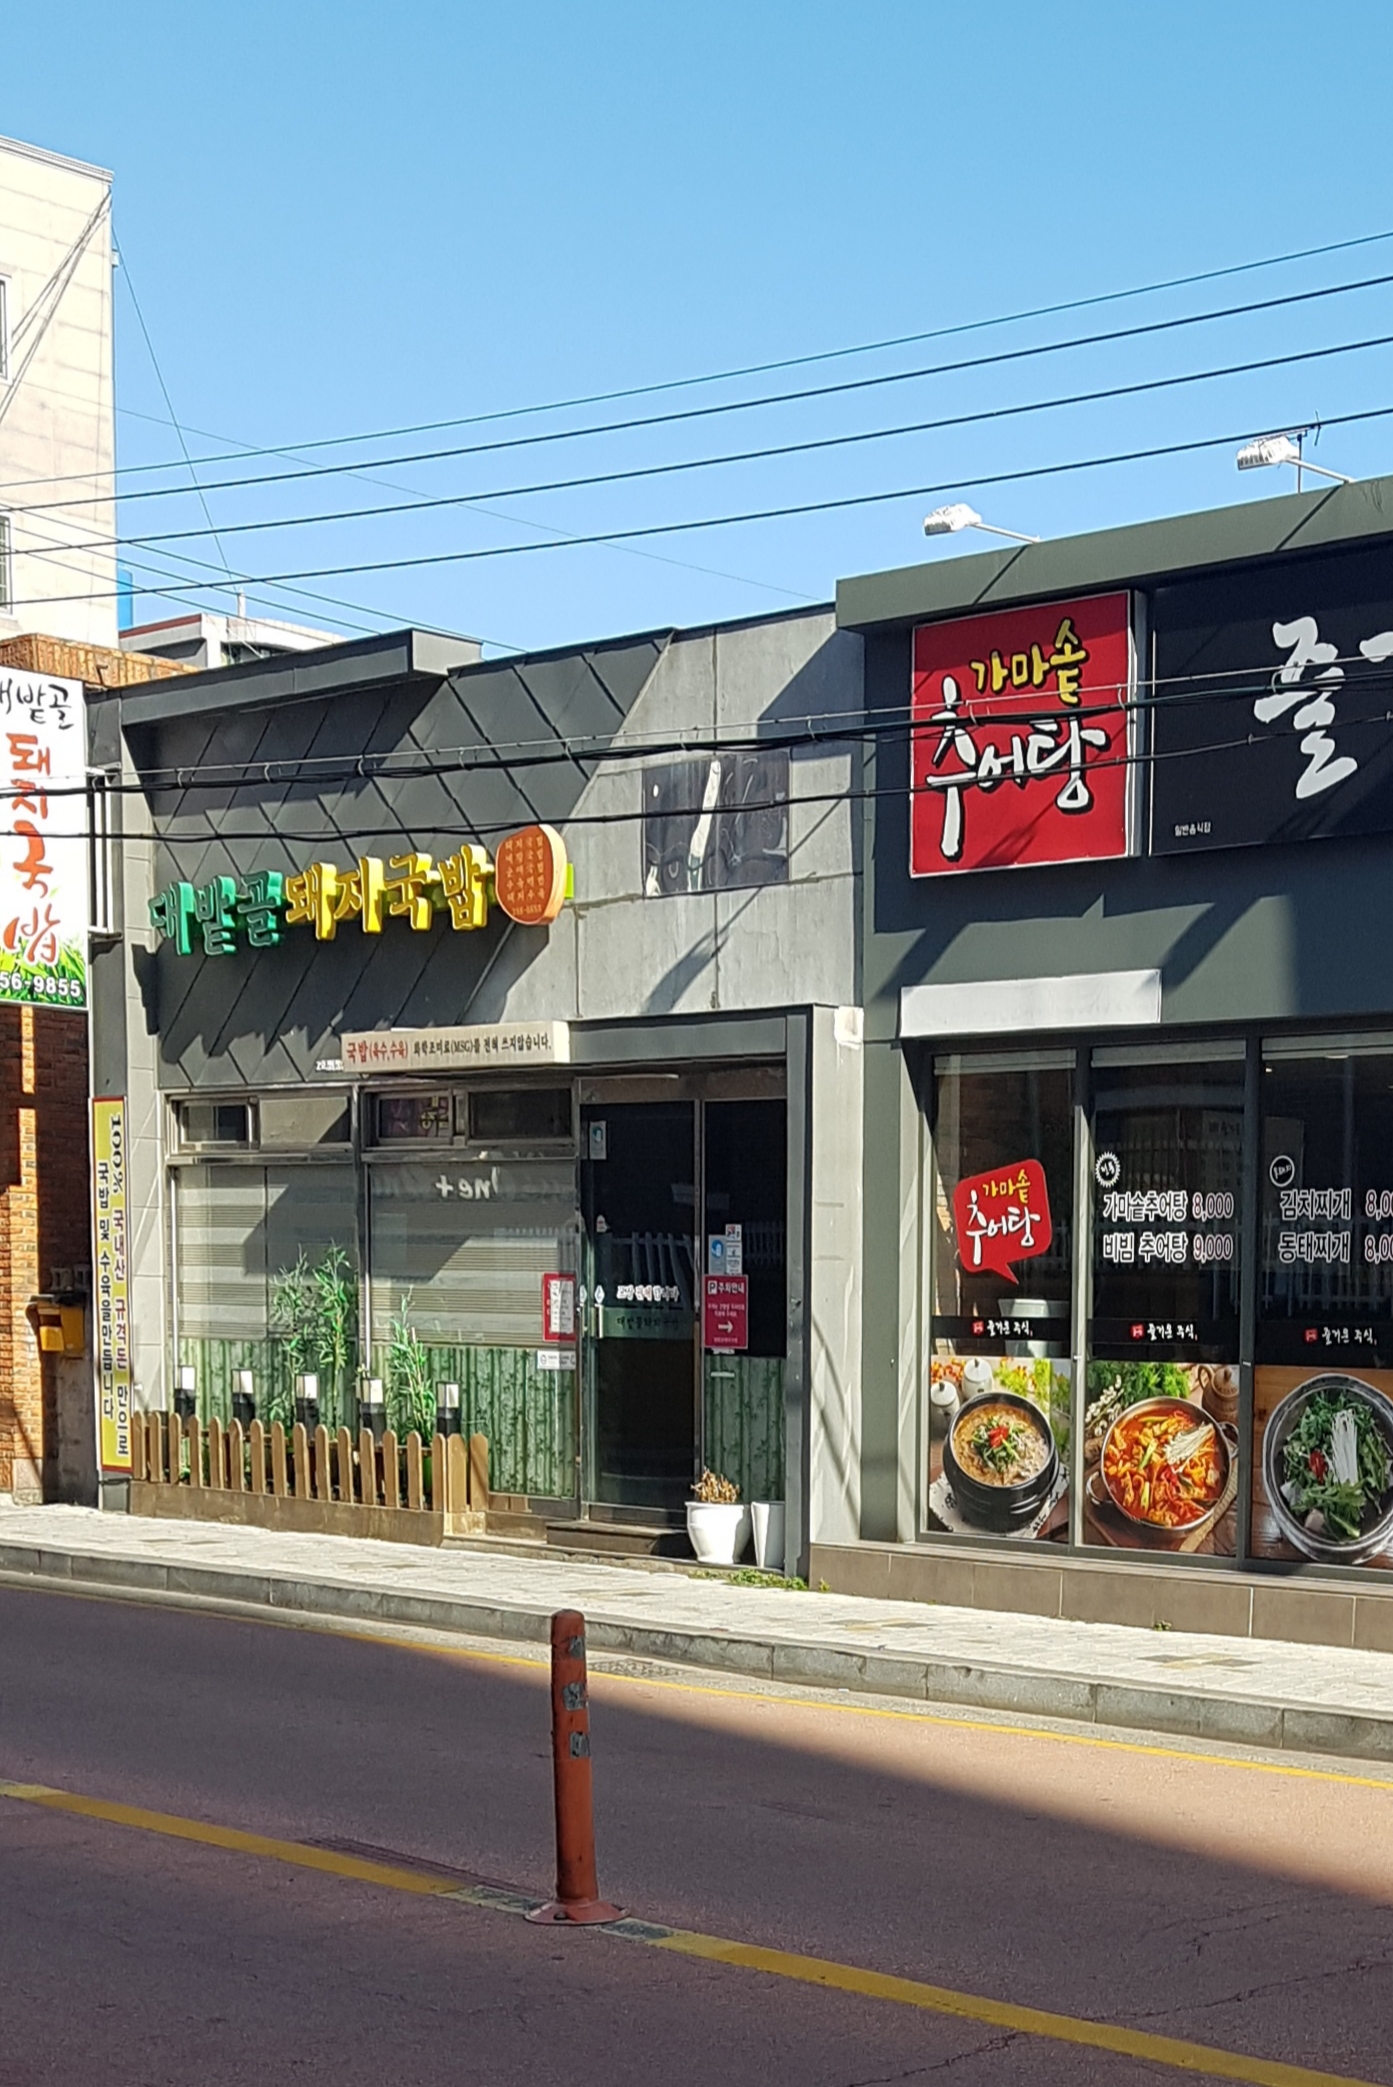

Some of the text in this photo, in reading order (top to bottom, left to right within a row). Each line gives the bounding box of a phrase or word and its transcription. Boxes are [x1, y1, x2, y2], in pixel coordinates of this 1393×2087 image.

[969, 617, 1088, 705] 가마솥
[1253, 615, 1393, 799] 즐
[926, 675, 1109, 858] 추어탕
[5, 731, 61, 965] 돼지국밥
[147, 869, 284, 957] 대밭골
[285, 843, 491, 940] 돼지국밥
[98, 1161, 109, 1209] 국밥
[110, 1114, 123, 1194] 100%
[982, 1168, 1031, 1204] 가마솥
[99, 1218, 110, 1242] 및
[965, 1189, 1041, 1266] 추어탕
[1102, 1190, 1235, 1222] 가마솥추어탕 8,000
[1279, 1187, 1352, 1221] 김치찌개
[112, 1209, 125, 1281] 국내산
[1102, 1231, 1234, 1264] 비빔 추어탕 9,000
[1278, 1231, 1352, 1264] 동태찌개
